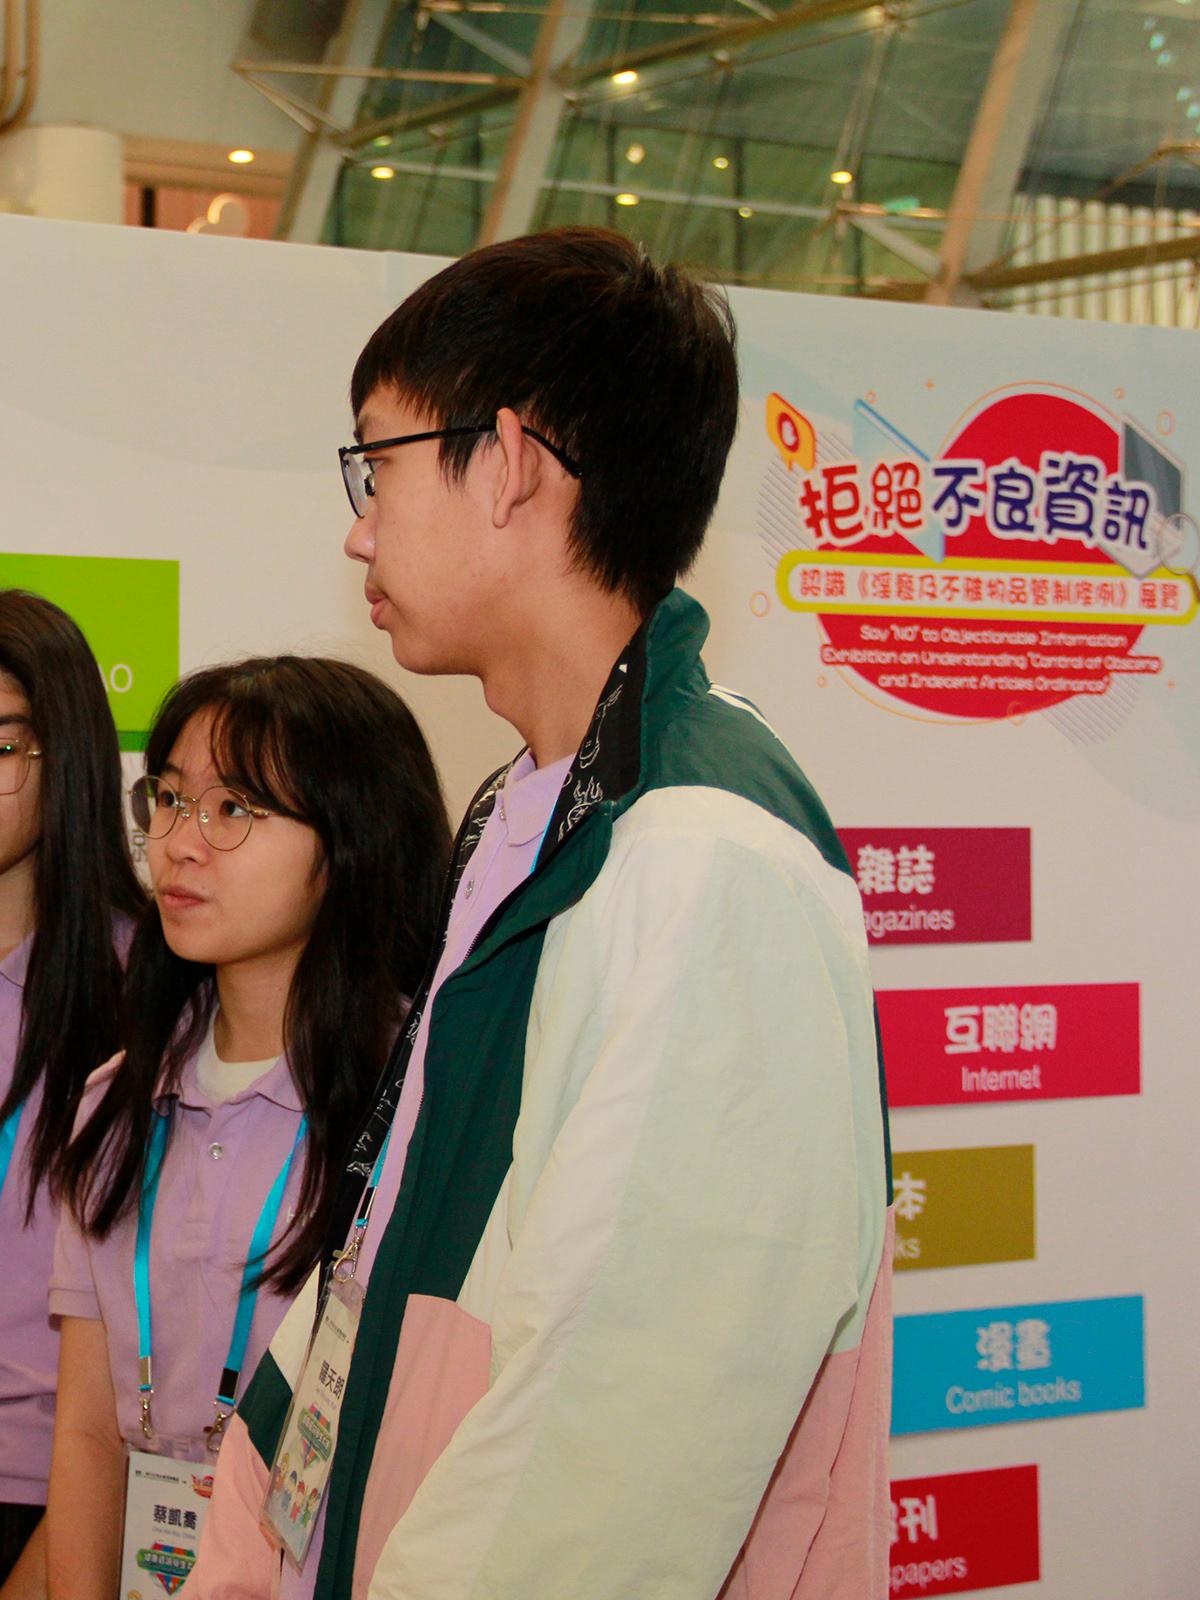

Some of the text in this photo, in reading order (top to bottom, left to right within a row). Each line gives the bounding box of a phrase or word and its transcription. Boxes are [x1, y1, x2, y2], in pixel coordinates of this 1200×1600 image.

[860, 624, 889, 642] Say
[921, 628, 940, 643] to
[941, 627, 1038, 646] Objectionable
[1039, 630, 1129, 648] Information
[821, 646, 897, 665] Exhibition
[899, 651, 920, 665] on
[921, 650, 1028, 670] Understanding
[1103, 655, 1161, 671] Obscene
[878, 673, 909, 688] and
[910, 672, 978, 690] Indecent
[856, 844, 935, 895] 雜誌
[944, 1002, 1058, 1056] 互聯網
[961, 1064, 1042, 1092] Internet
[945, 1376, 1082, 1415] Comic books
[891, 1494, 938, 1543] 刊
